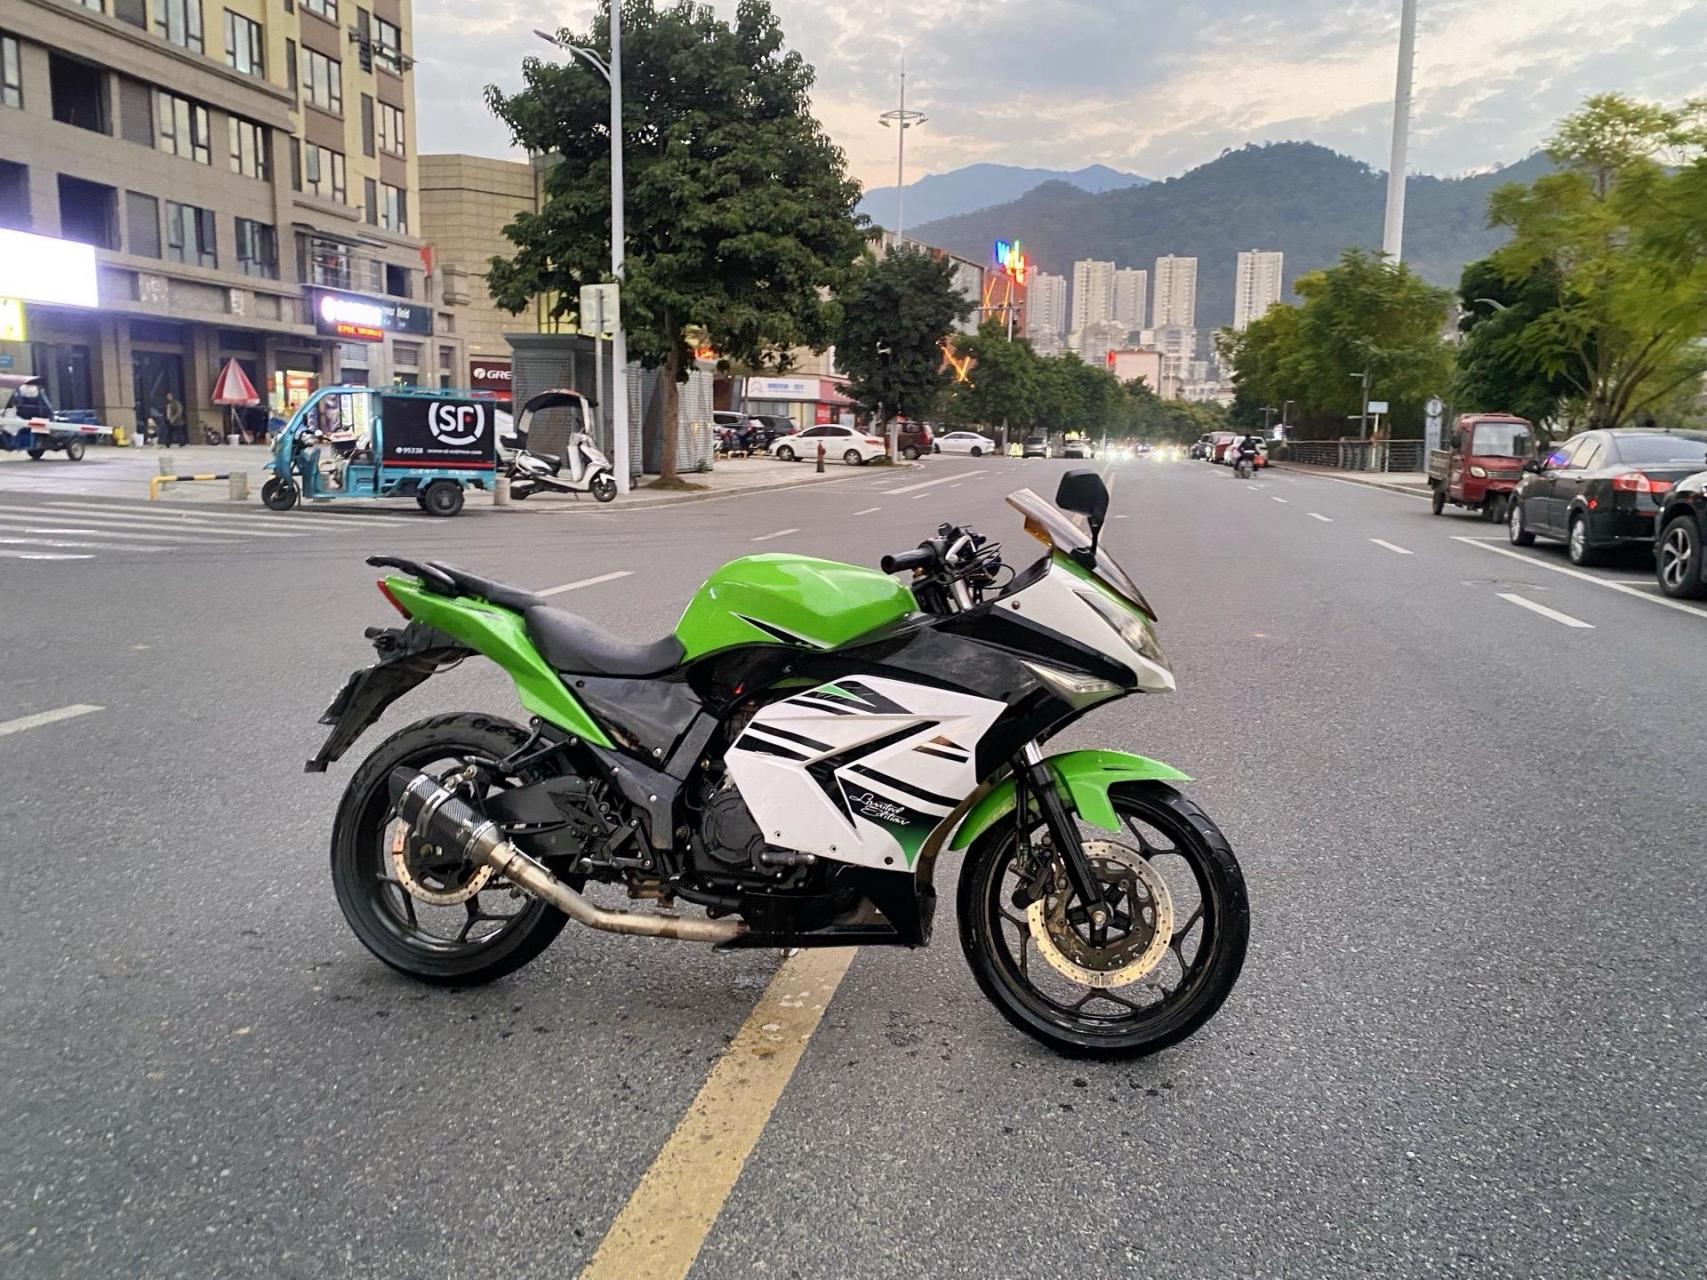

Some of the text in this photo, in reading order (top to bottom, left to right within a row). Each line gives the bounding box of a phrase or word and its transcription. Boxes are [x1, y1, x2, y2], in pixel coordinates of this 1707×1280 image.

[487, 370, 512, 380] GRE
[849, 792, 905, 814] Limited
[860, 806, 911, 825] Edition
